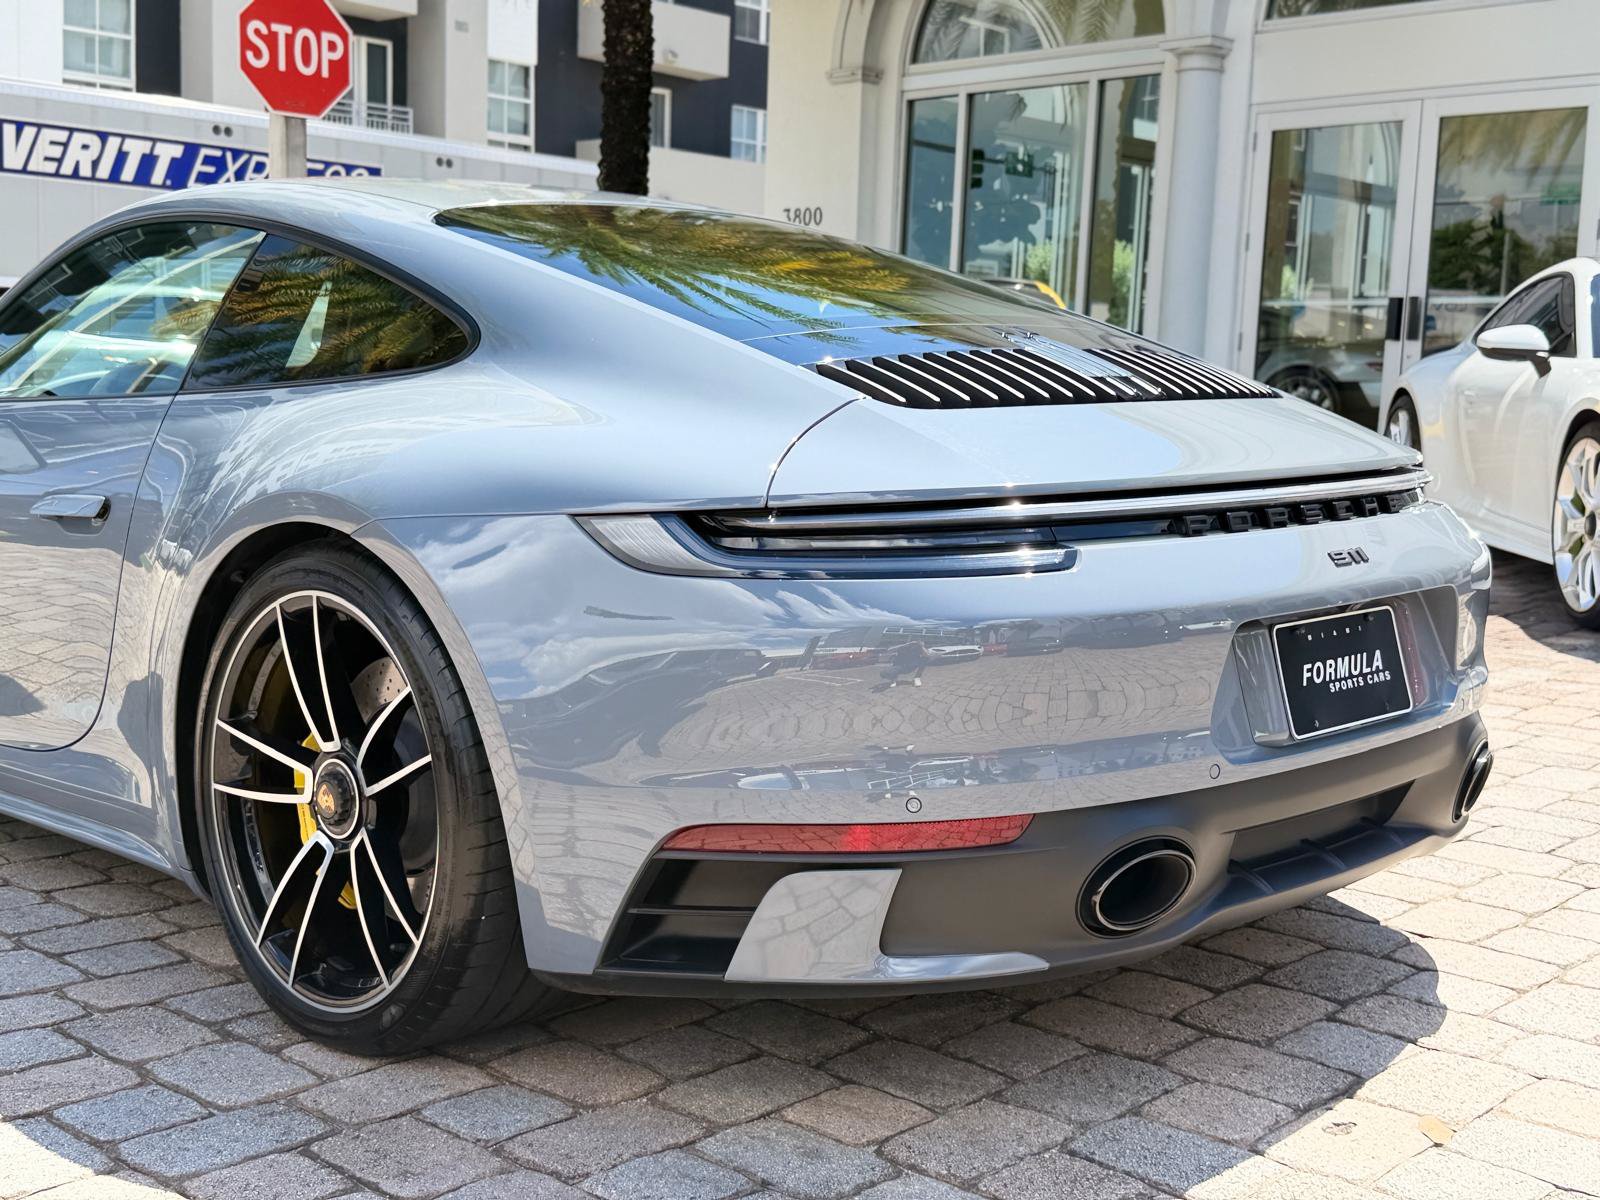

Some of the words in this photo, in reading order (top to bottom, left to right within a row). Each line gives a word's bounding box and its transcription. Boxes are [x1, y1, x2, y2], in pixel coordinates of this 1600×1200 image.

[245, 19, 344, 79] STOP
[1182, 493, 1408, 537] PORSCHE
[1327, 546, 1370, 568] 911
[1302, 649, 1383, 687] FORMULA
[1329, 676, 1365, 693] SPORTS
[1367, 670, 1392, 684] CARS
